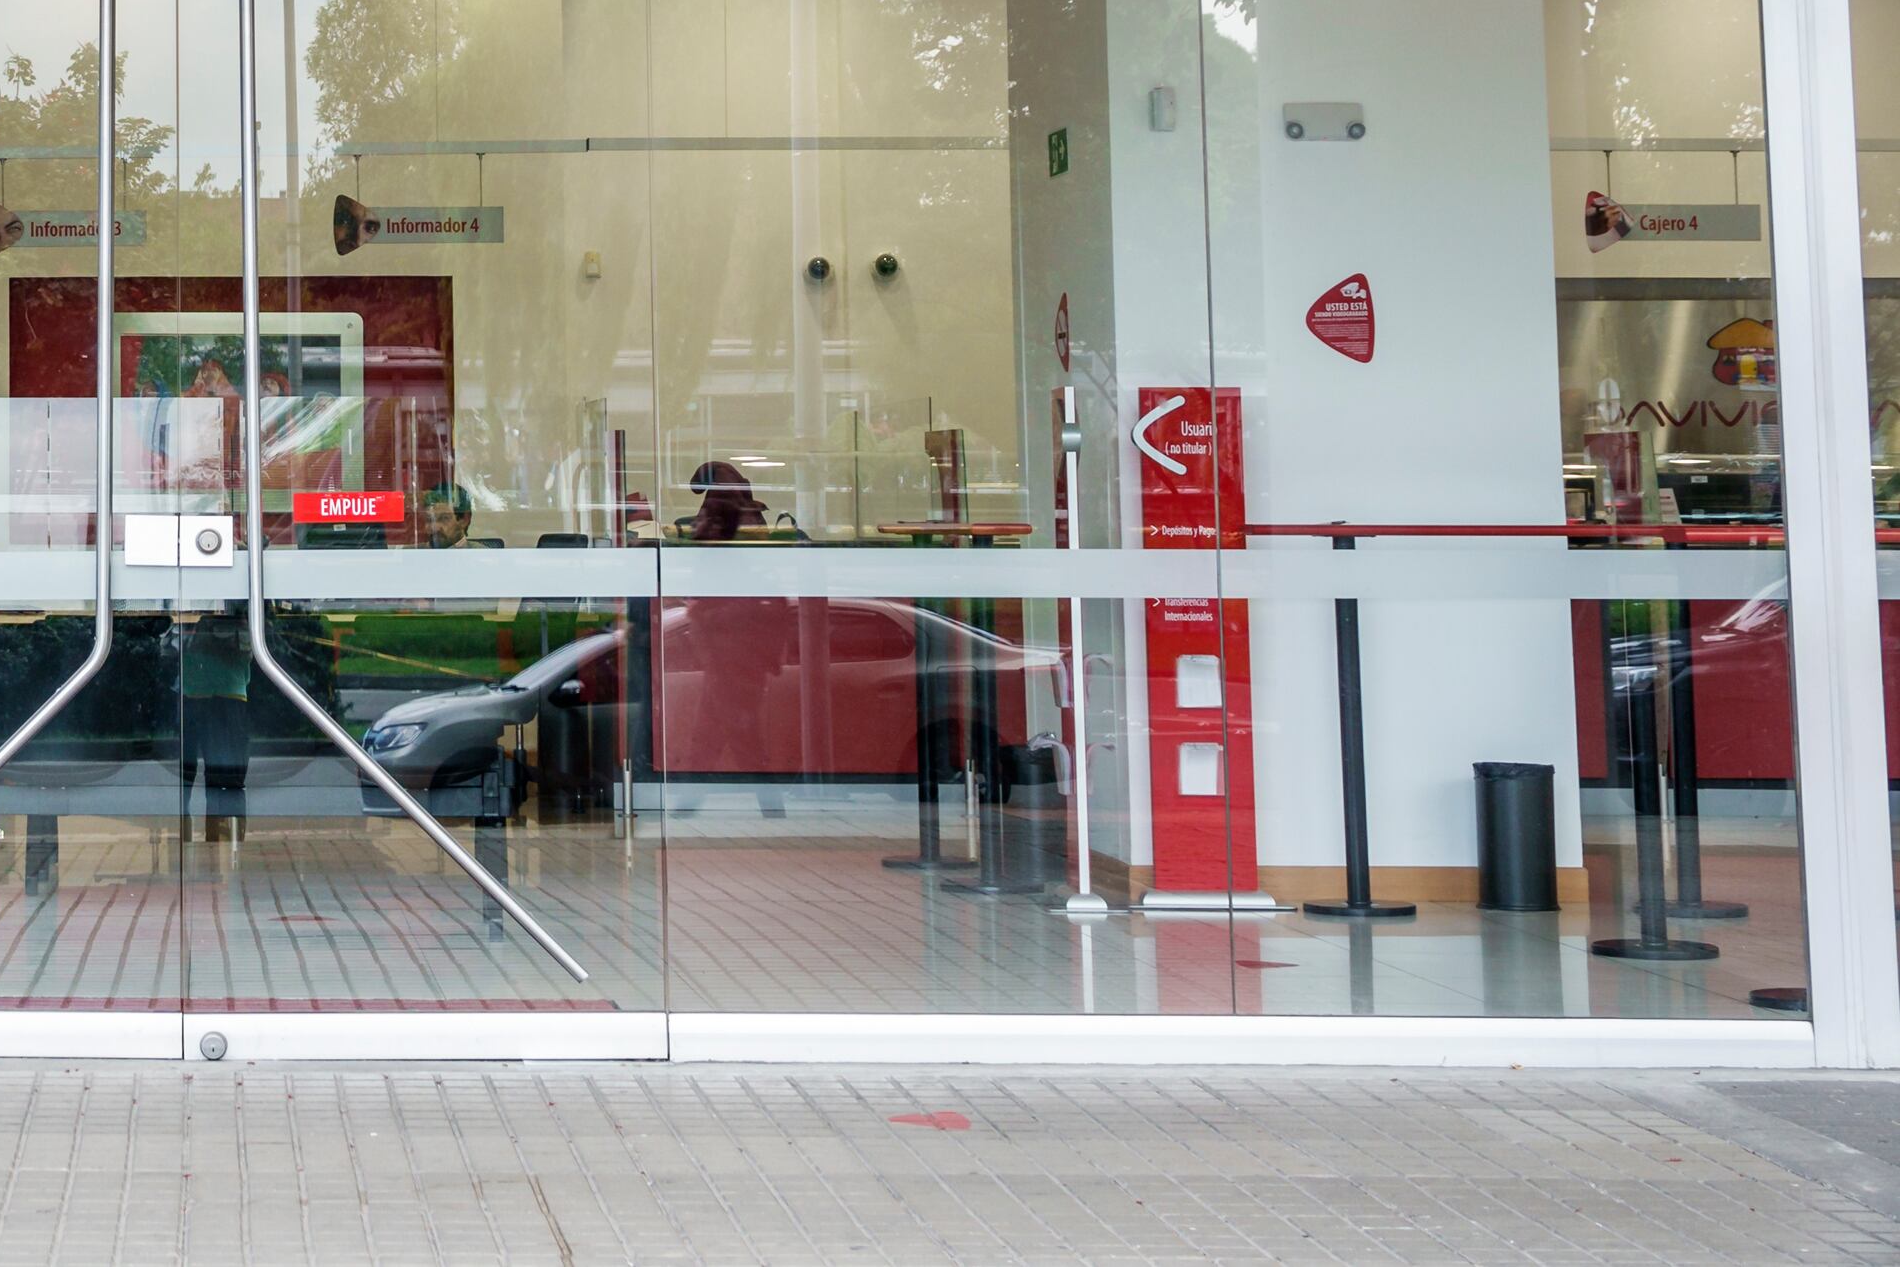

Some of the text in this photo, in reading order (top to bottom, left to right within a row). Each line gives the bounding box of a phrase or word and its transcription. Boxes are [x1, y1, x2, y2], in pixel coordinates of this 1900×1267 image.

[30, 220, 121, 237] Informad 3
[386, 217, 479, 233] Informador 4
[1640, 214, 1698, 235] Cajero 4
[1325, 302, 1349, 311] USTED
[1180, 421, 1213, 436] Usuari
[320, 497, 377, 516] EMPUJE
[1164, 610, 1213, 621] Internacionales
